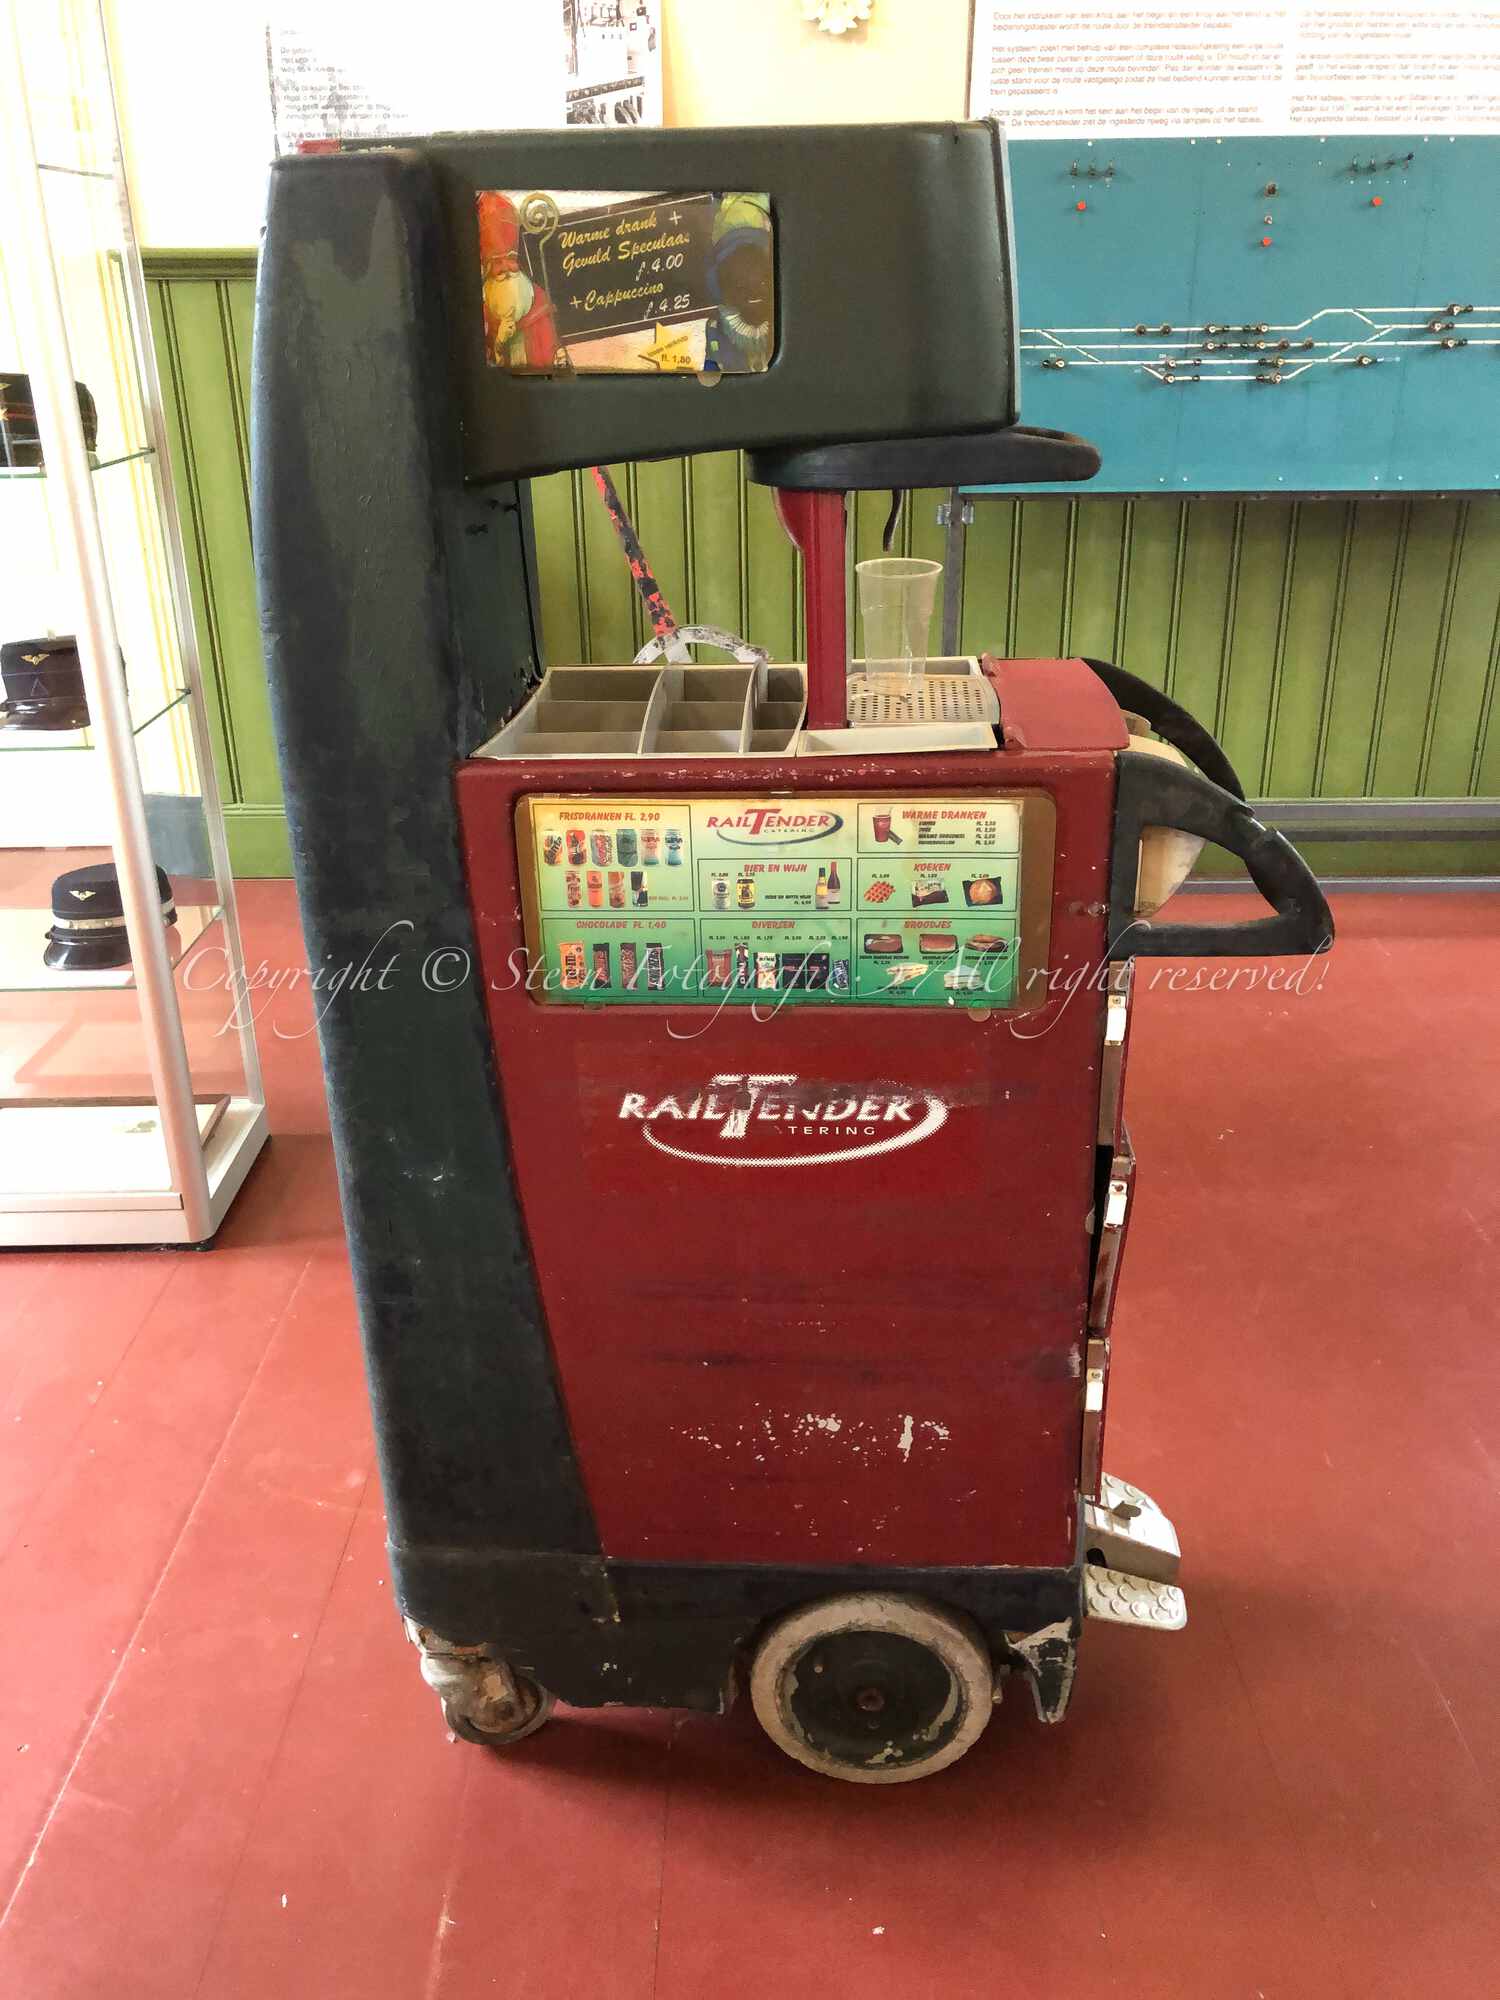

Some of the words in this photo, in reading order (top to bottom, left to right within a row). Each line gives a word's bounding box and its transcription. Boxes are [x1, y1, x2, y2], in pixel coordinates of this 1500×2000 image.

[559, 227, 610, 249] Warme
[615, 210, 657, 236] drank
[562, 245, 611, 277] Gevuld
[559, 812, 622, 821] FRISDRANKEN
[902, 810, 938, 820] WARME
[941, 810, 987, 820] DRANKEN
[707, 808, 830, 835] RAILTENDER
[768, 864, 780, 873] EN
[783, 864, 808, 873] WIJN
[913, 863, 951, 873] KOEKEN
[576, 921, 627, 929] CHOCOLADE
[617, 1073, 914, 1138] RAILTENDER
